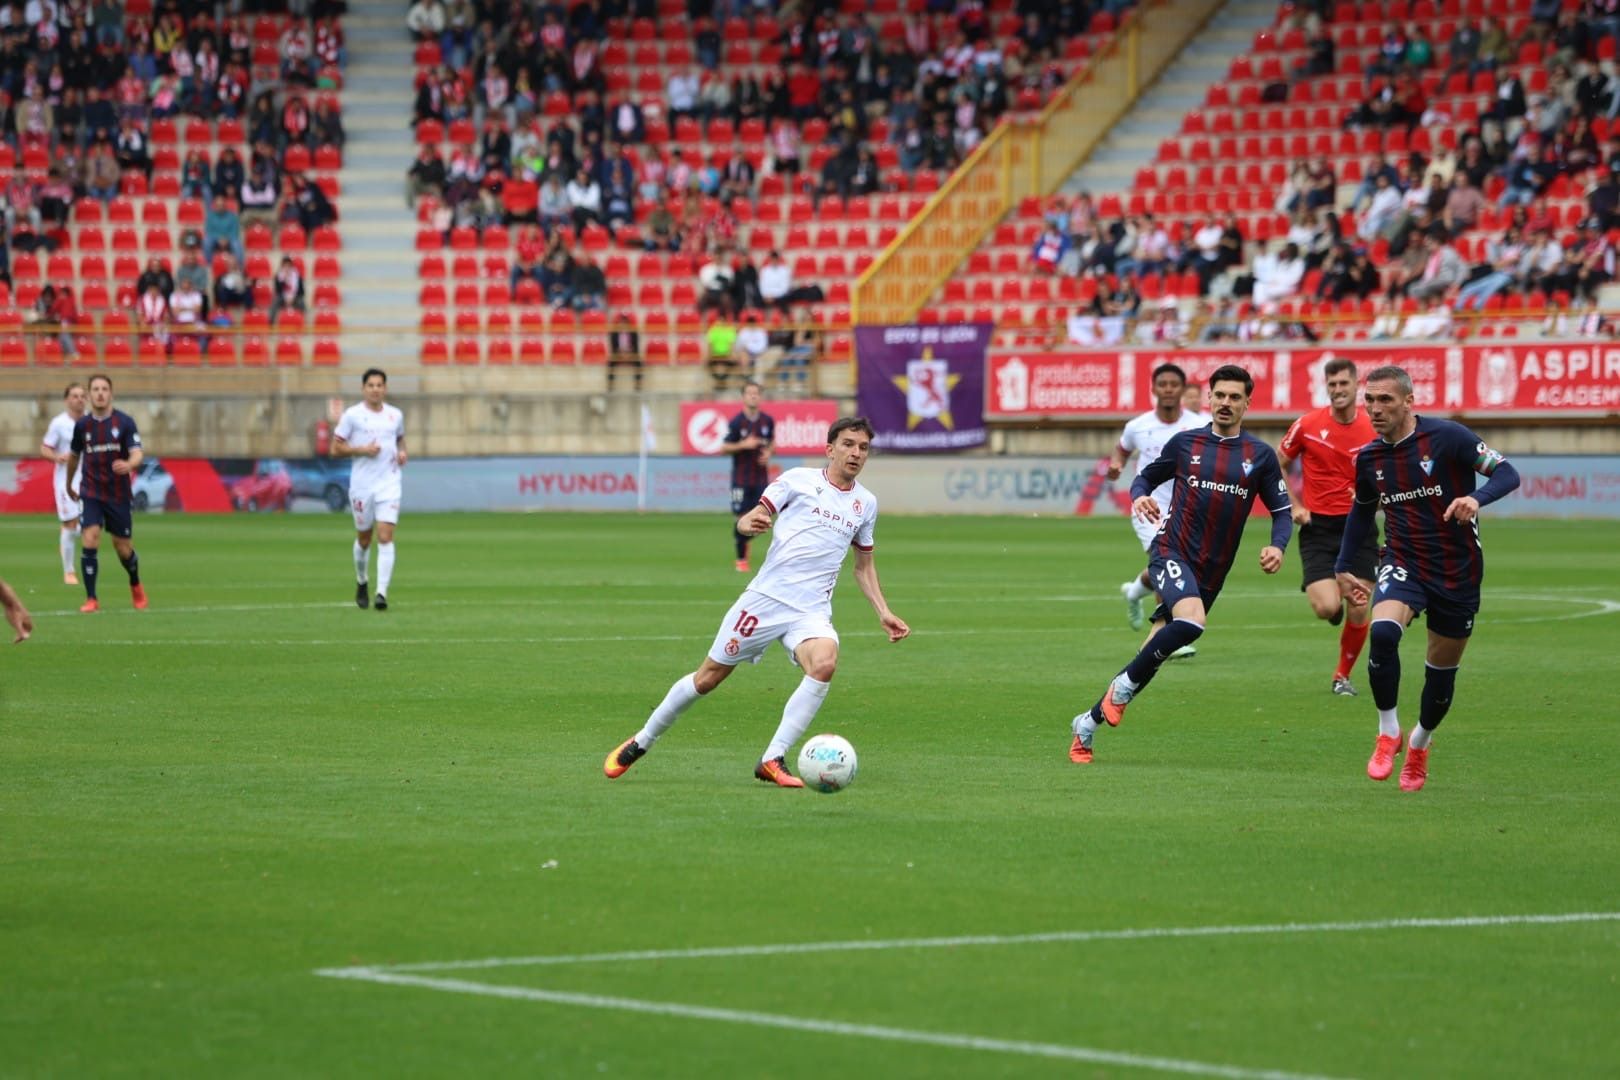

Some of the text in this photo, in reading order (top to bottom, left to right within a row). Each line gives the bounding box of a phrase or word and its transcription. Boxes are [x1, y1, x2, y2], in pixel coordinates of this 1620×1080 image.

[518, 473, 637, 495] HYUNDA
[1200, 480, 1248, 499] smartlog
[1391, 485, 1443, 502] smartlog
[811, 507, 859, 533] ASPIRE
[1166, 559, 1182, 578] 6
[1378, 564, 1408, 583] 23
[733, 609, 758, 637] 10
